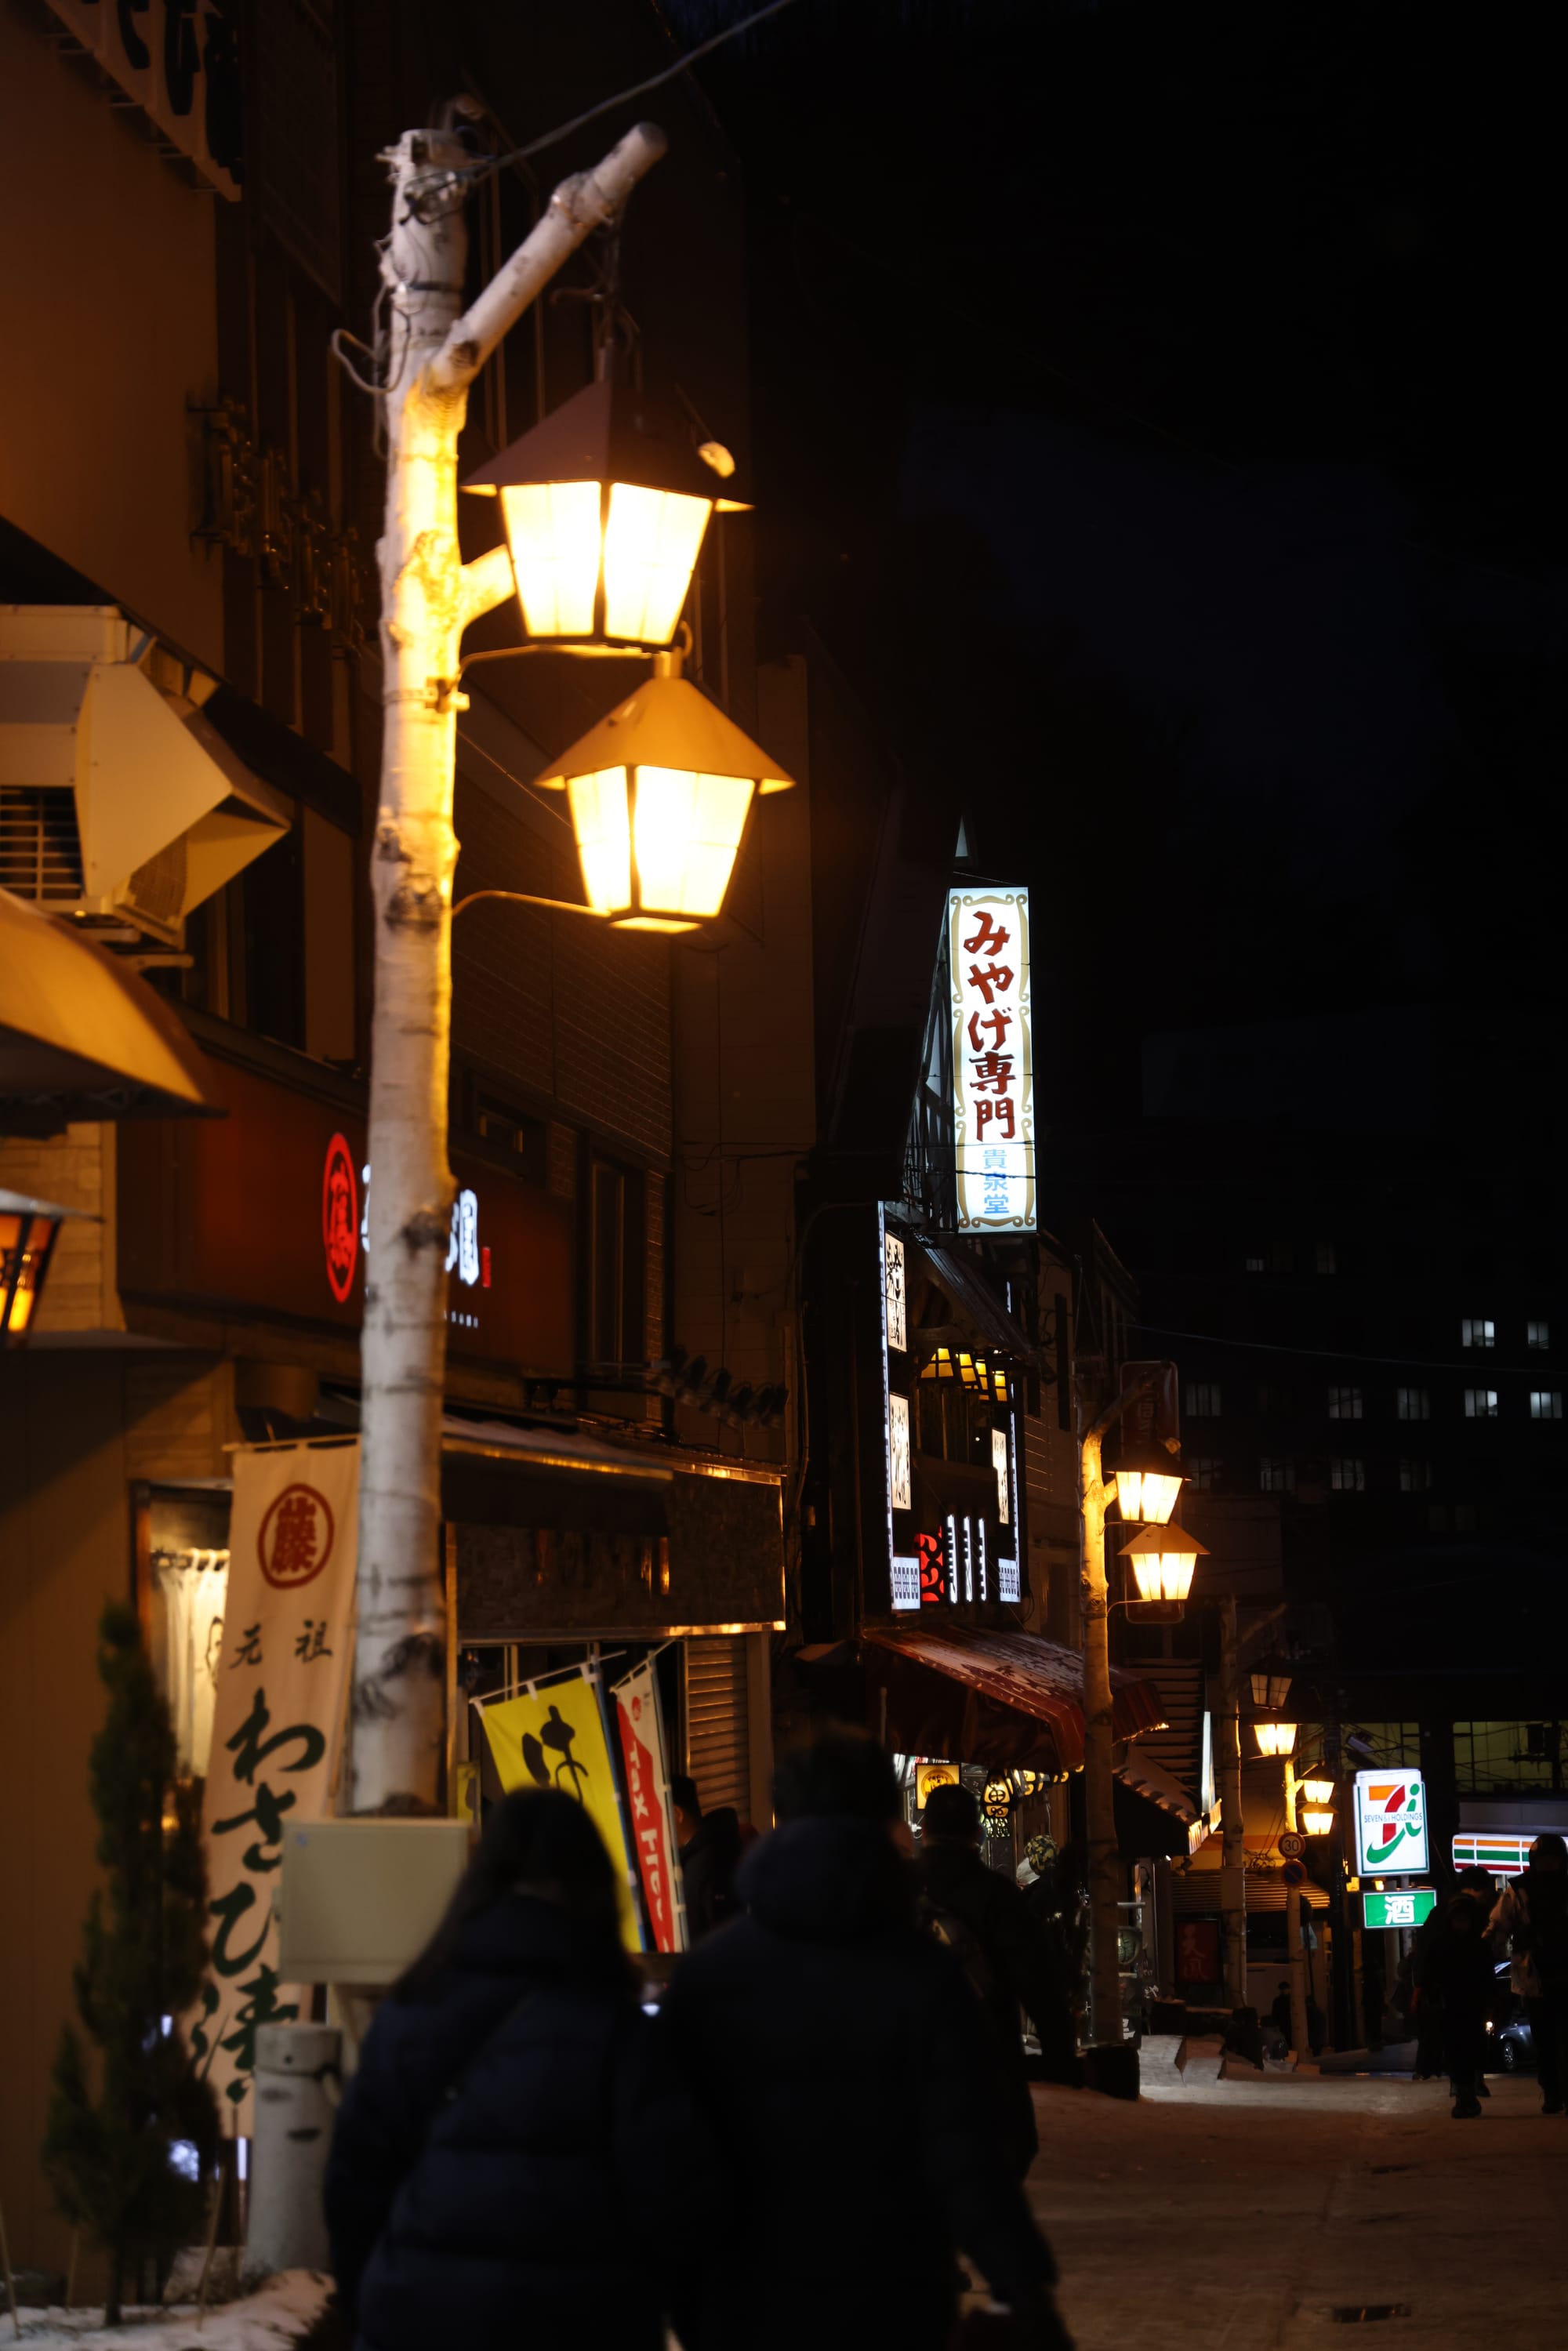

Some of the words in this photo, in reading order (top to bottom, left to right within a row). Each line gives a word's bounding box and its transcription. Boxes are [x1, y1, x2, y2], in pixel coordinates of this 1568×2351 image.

[963, 910, 1016, 1142] みやげ専門
[982, 1148, 1010, 1214] 貴泉堂
[1391, 1812, 1424, 1823] HOLDINGS
[1284, 1839, 1299, 1852] 30
[1385, 1895, 1415, 1925] 酒
